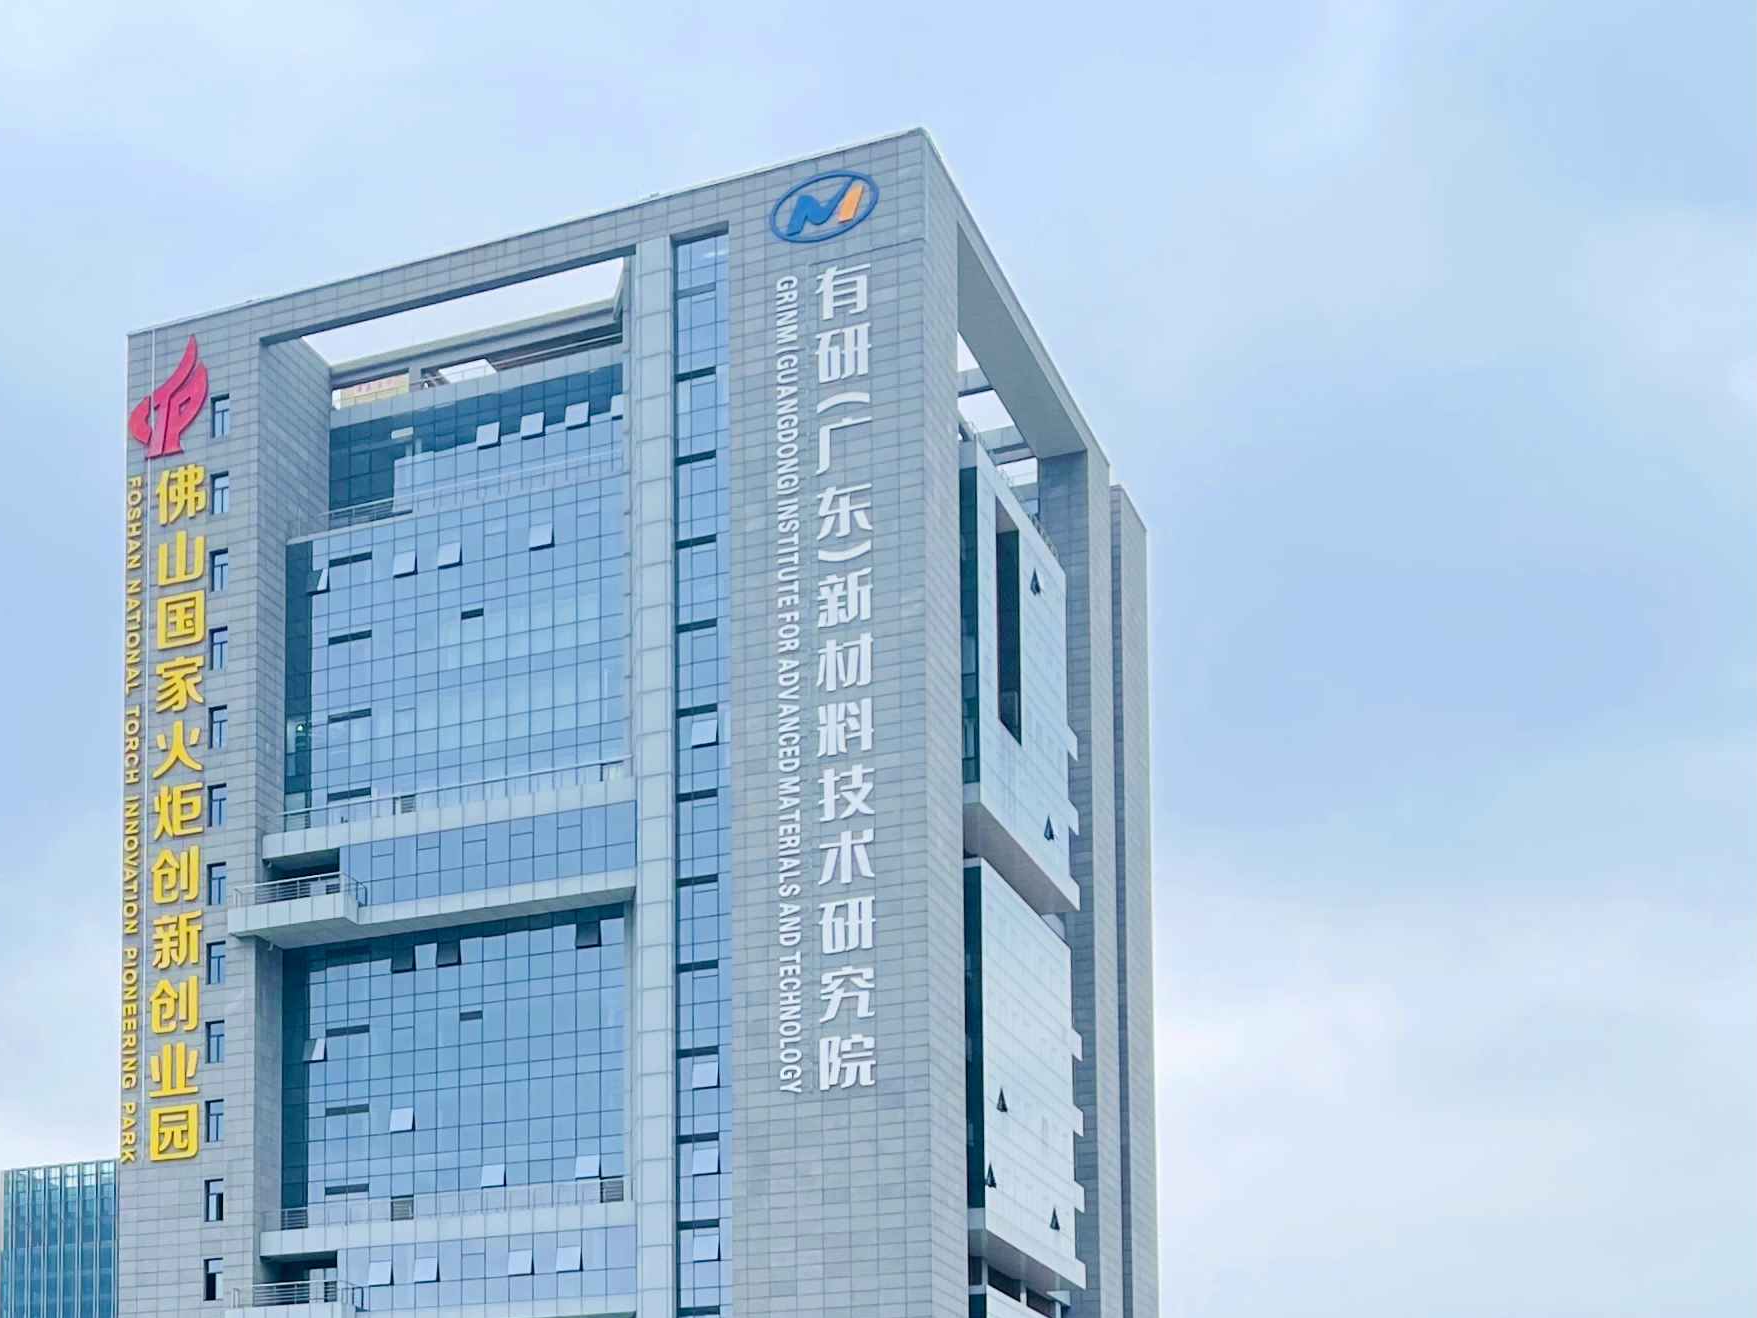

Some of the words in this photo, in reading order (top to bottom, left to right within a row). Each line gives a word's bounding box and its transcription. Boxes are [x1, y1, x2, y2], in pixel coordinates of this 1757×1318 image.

[776, 276, 798, 345] GRINM
[126, 475, 142, 569] FOSHAN
[777, 498, 799, 608] INSTITUTE
[125, 578, 141, 694] NATIONAL
[778, 611, 799, 653] FOR
[124, 704, 141, 784] TORCH
[778, 659, 800, 772] ADVANCED
[123, 795, 140, 934] INNOVATION
[149, 464, 207, 1161] 佛山国家火炬创新创业园
[778, 776, 801, 897] MATERIALS
[779, 903, 801, 946] AND
[121, 946, 138, 1090] PIONEERING
[779, 951, 802, 1093] TECHNOLOGY
[120, 1102, 137, 1164] PARK
